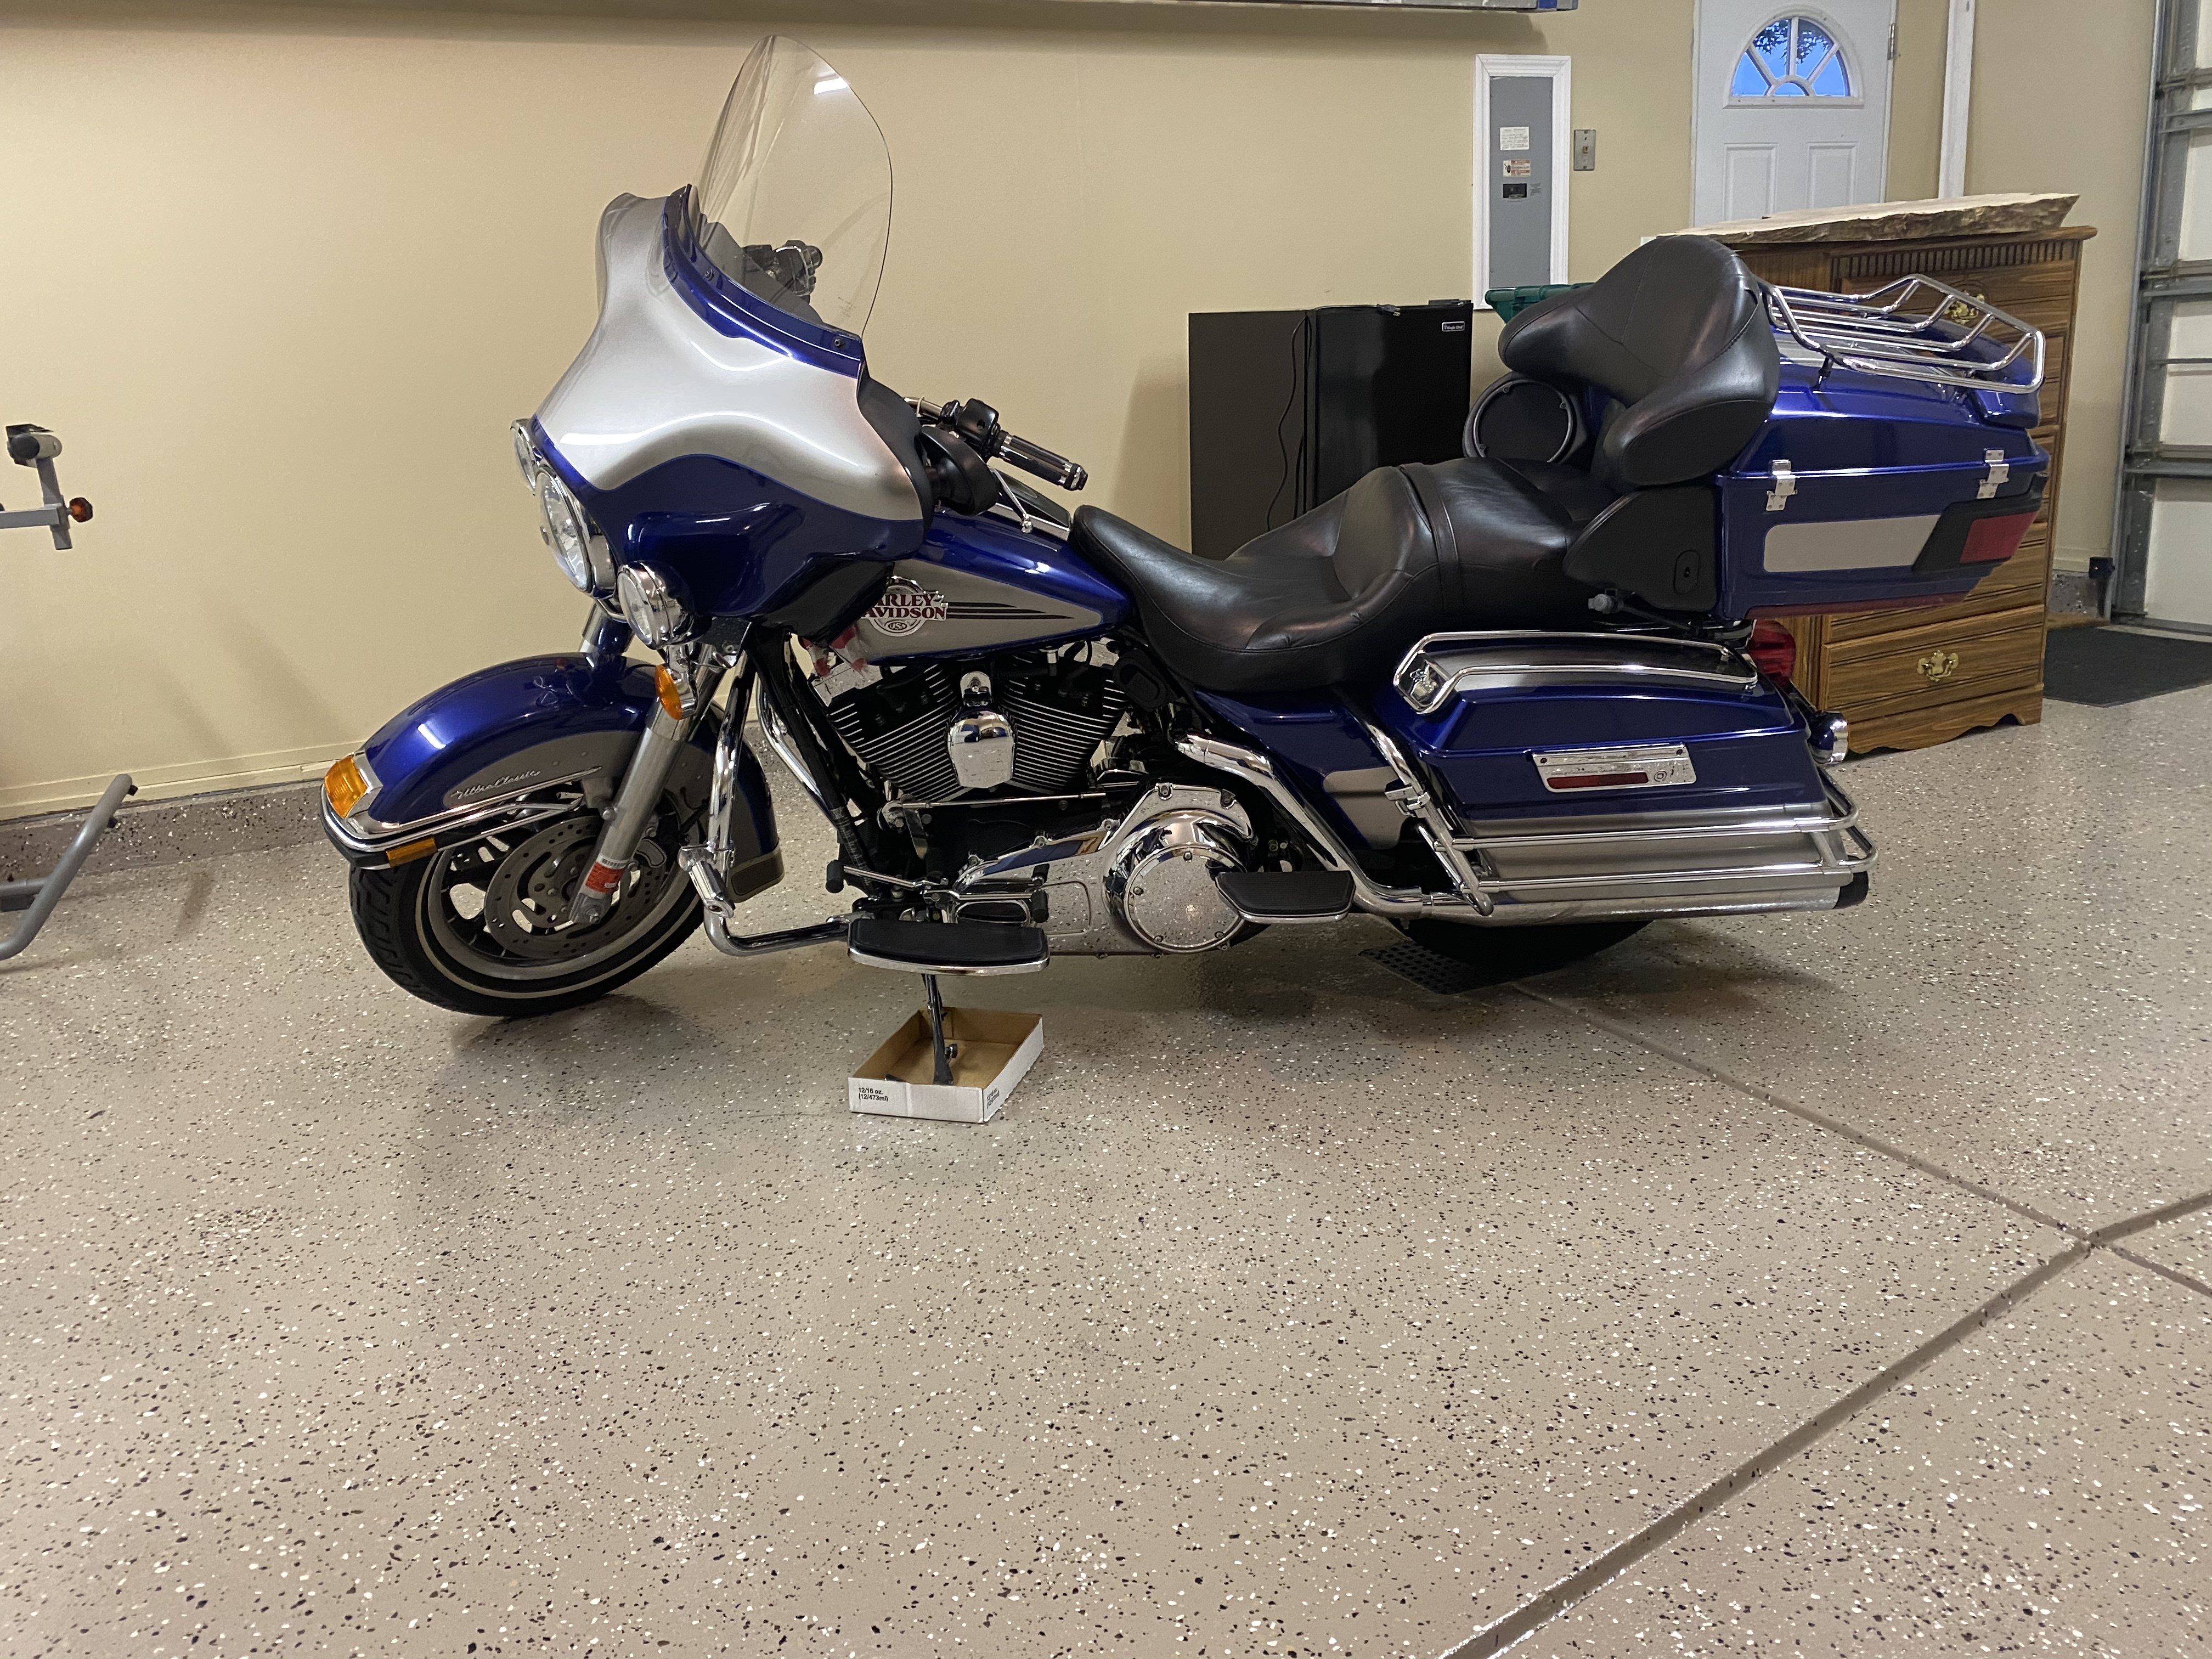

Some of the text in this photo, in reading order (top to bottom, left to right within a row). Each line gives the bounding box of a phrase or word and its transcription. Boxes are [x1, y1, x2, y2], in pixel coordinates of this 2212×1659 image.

[864, 607, 946, 619] AVIDSON
[889, 622, 906, 630] USA
[450, 770, 541, 799] Ultra Classic
